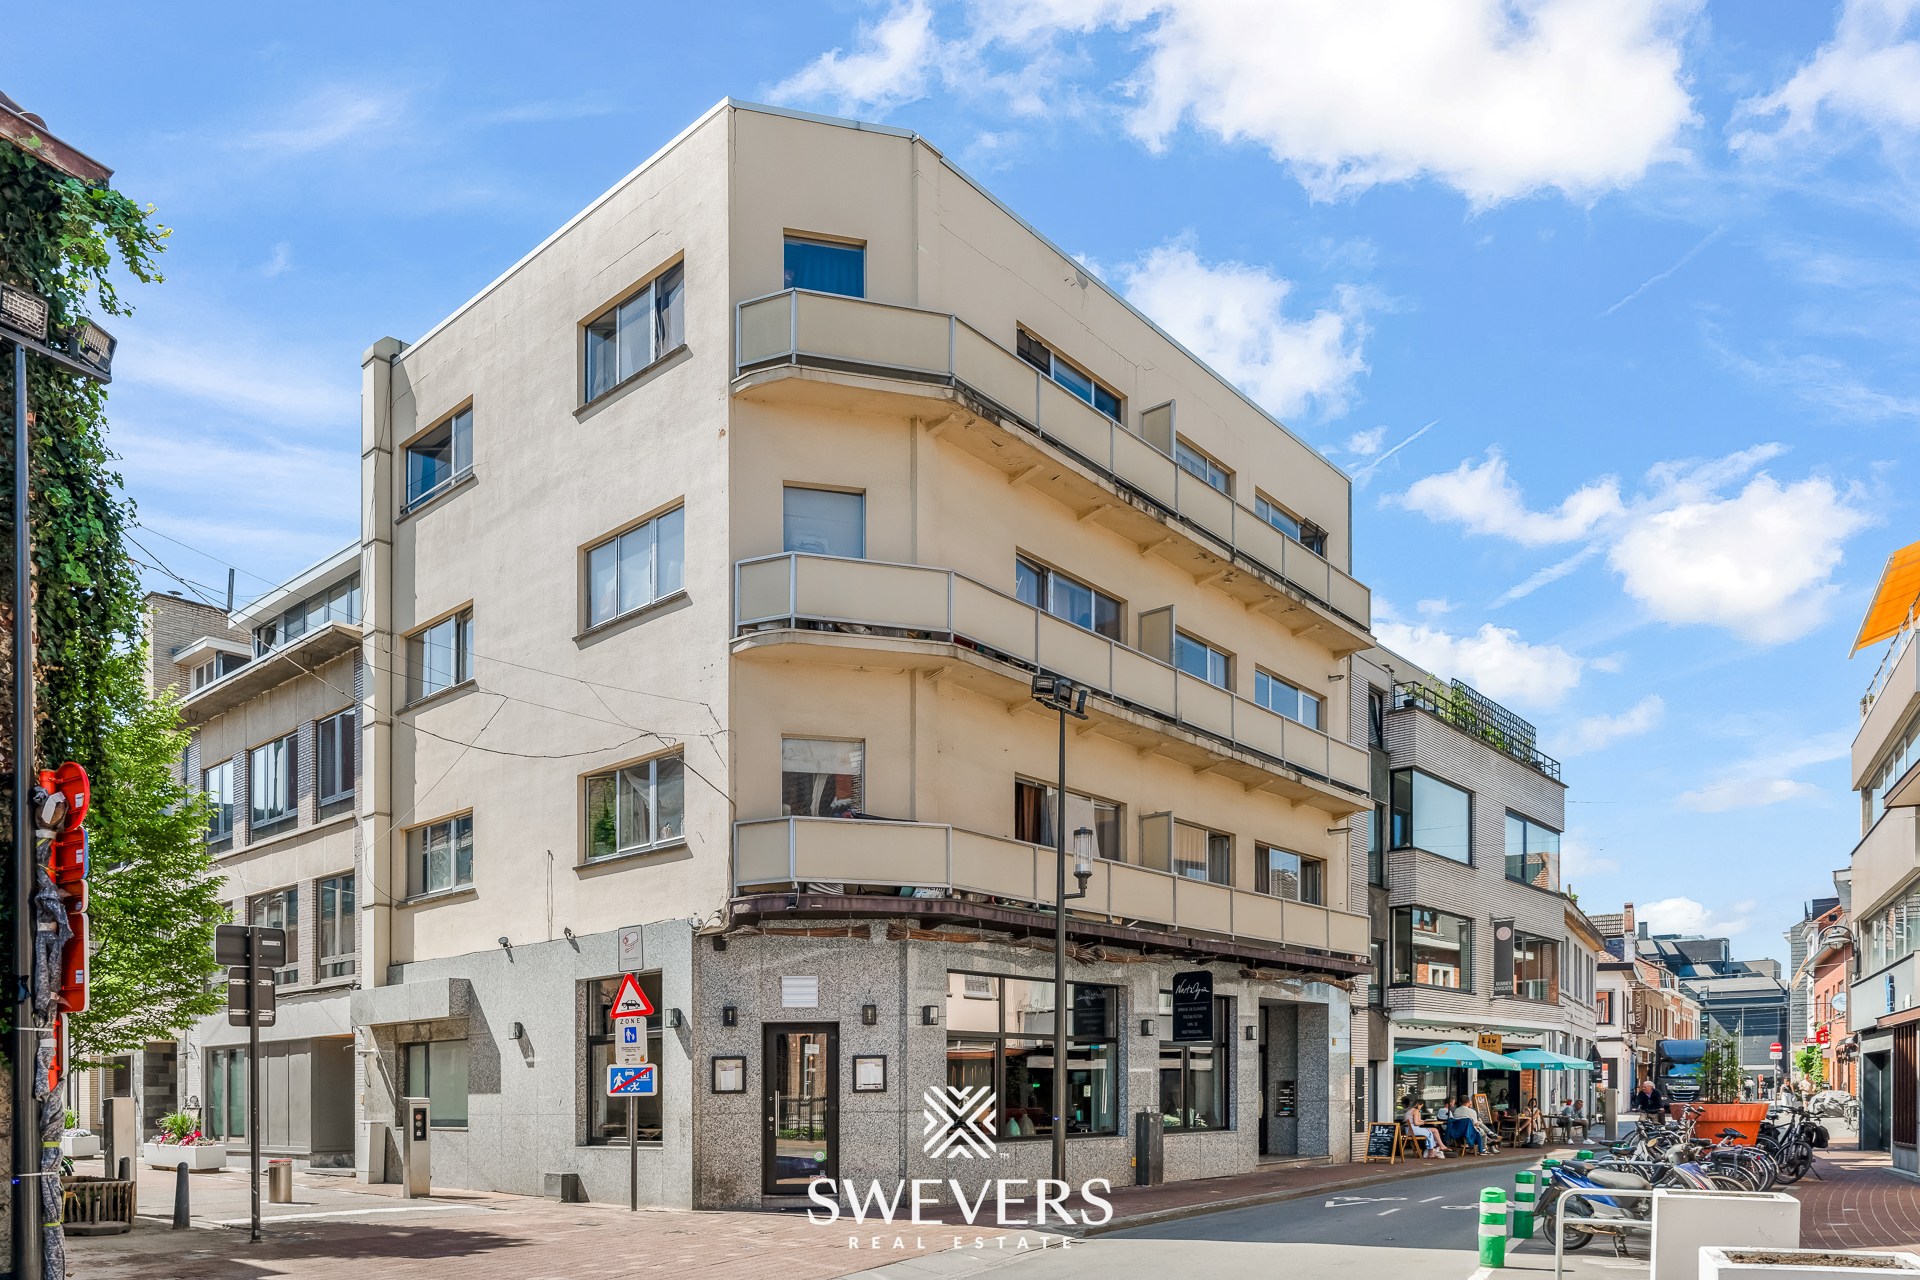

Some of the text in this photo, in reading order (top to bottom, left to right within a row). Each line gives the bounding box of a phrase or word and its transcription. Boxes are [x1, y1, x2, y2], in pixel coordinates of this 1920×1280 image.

[619, 1017, 641, 1025] ZONE
[1482, 1036, 1497, 1044] Liv
[1374, 1125, 1389, 1134] Liv
